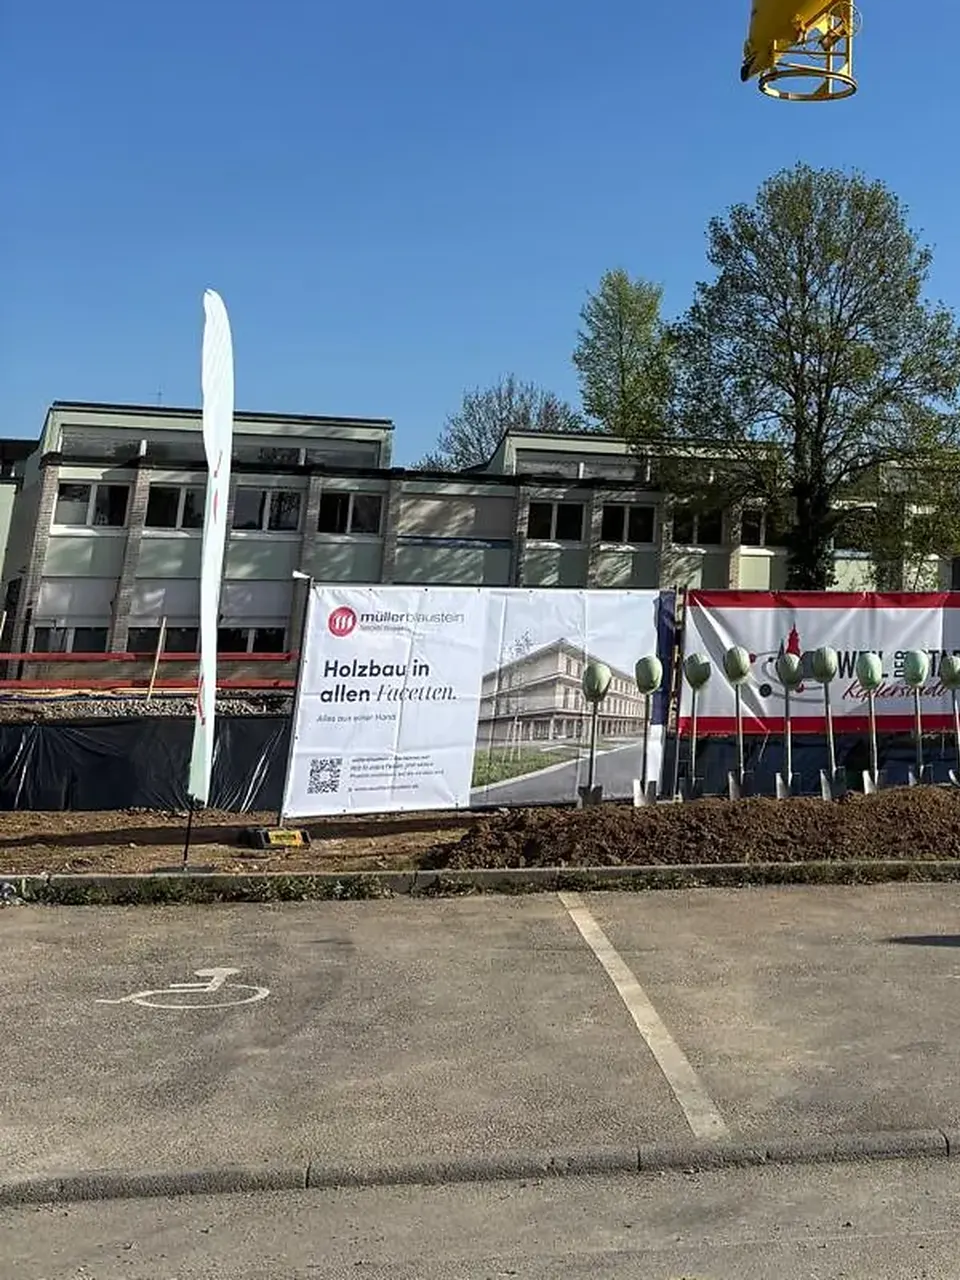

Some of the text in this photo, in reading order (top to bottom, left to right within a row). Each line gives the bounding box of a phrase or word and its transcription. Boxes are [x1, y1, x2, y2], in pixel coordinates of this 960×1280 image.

[323, 658, 430, 678] Holzbau in
[837, 650, 889, 679] WL
[320, 683, 457, 703] allen Facetten.
